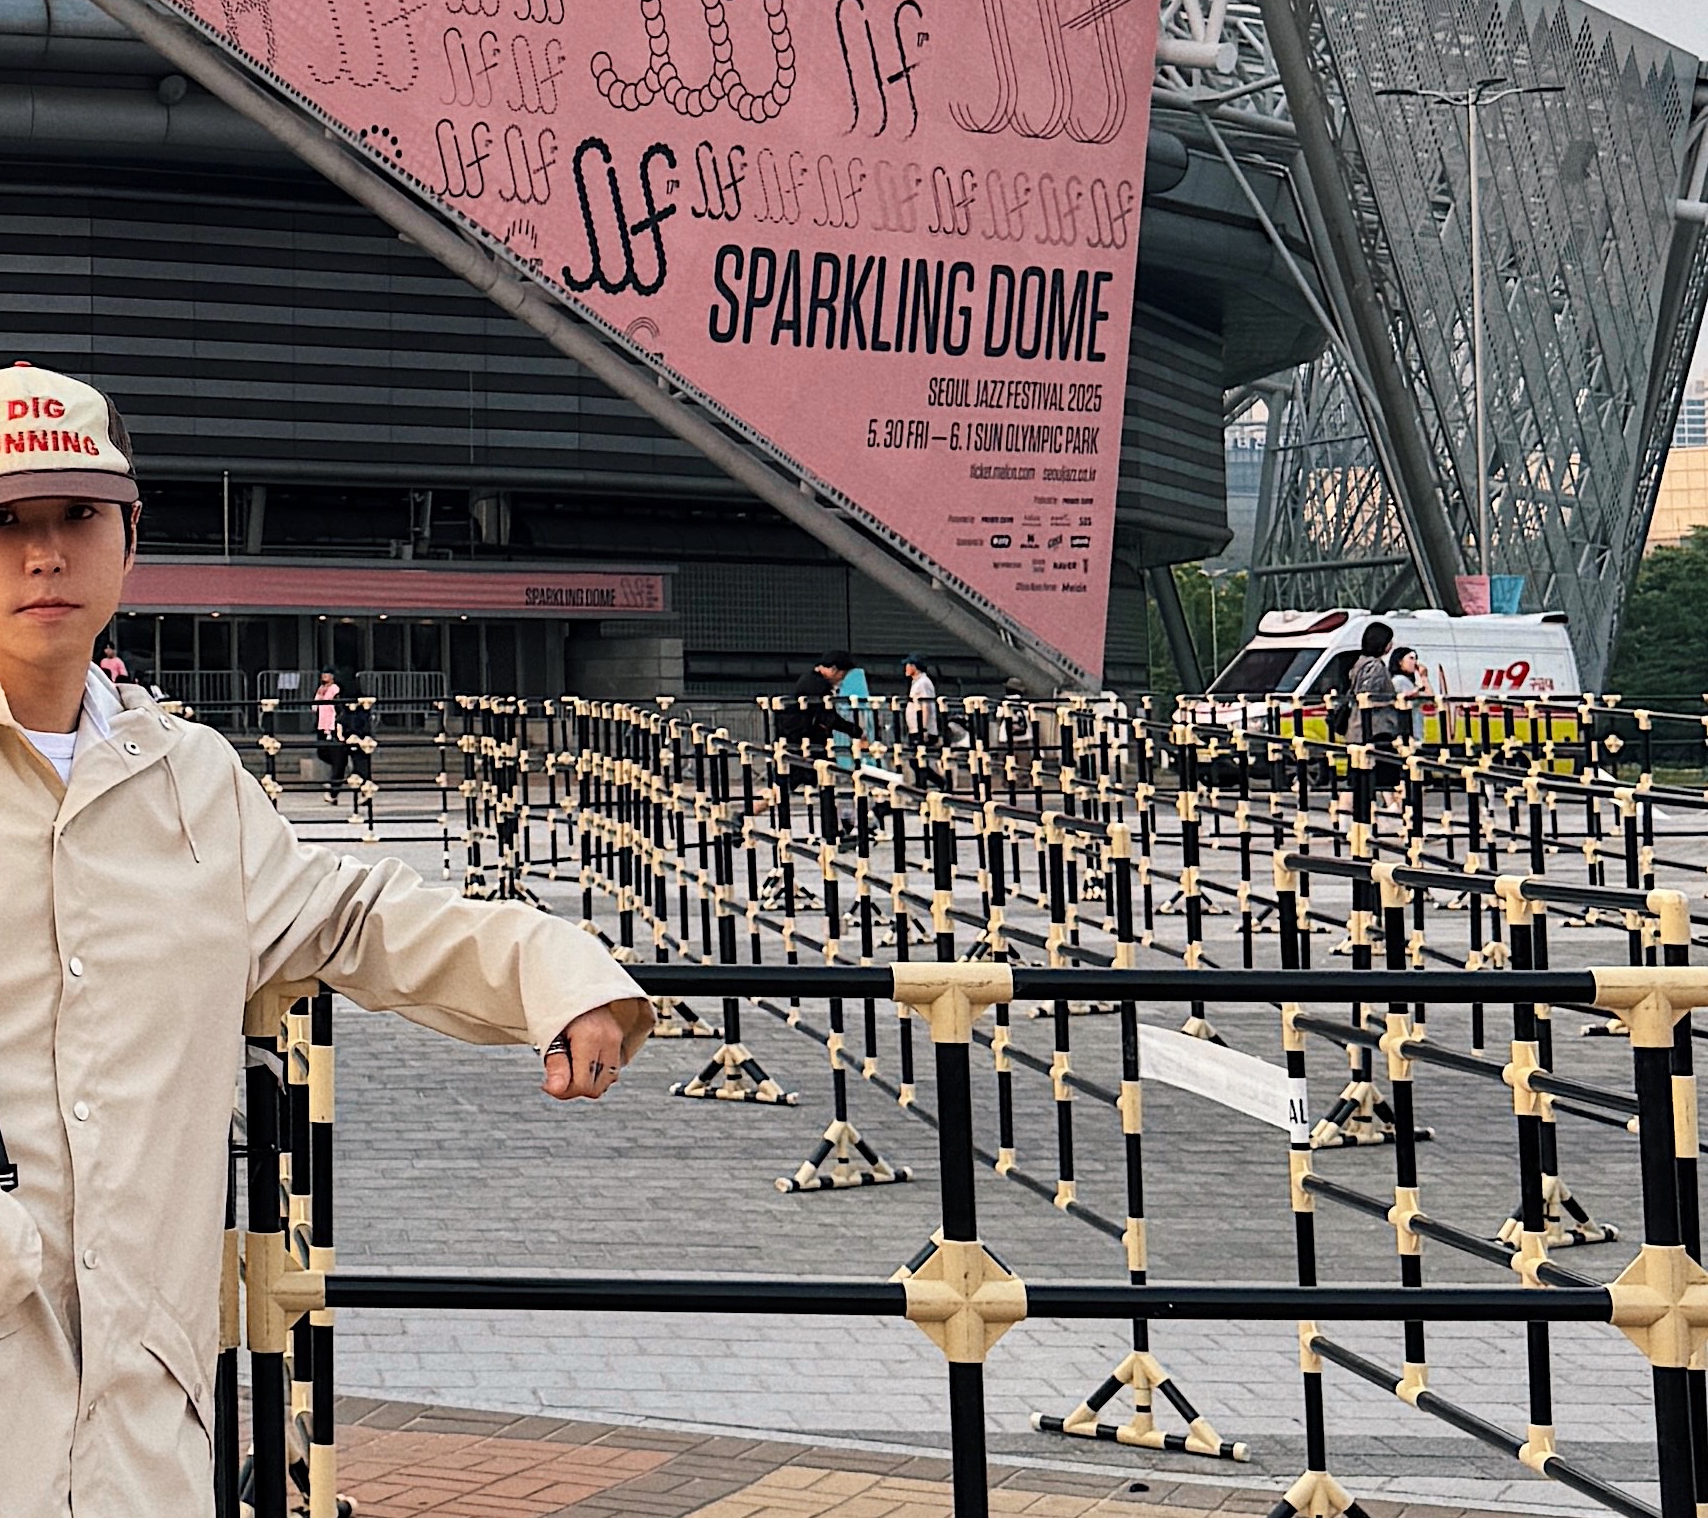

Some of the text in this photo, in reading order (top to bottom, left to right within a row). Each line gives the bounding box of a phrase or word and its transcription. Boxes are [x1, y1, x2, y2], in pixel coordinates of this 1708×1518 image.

[709, 244, 1113, 362] SPARKLING DOME
[7, 397, 65, 420] DIG
[928, 377, 1103, 413] SEOUL JAZZ FESTIVAL 2025
[907, 420, 929, 450] FRI
[974, 422, 1003, 452] SUN
[1006, 423, 1063, 454] OLYMPIC
[1065, 426, 1100, 455] PARK
[525, 587, 616, 607] SPARKLING DOME
[1481, 661, 1530, 690] 119
